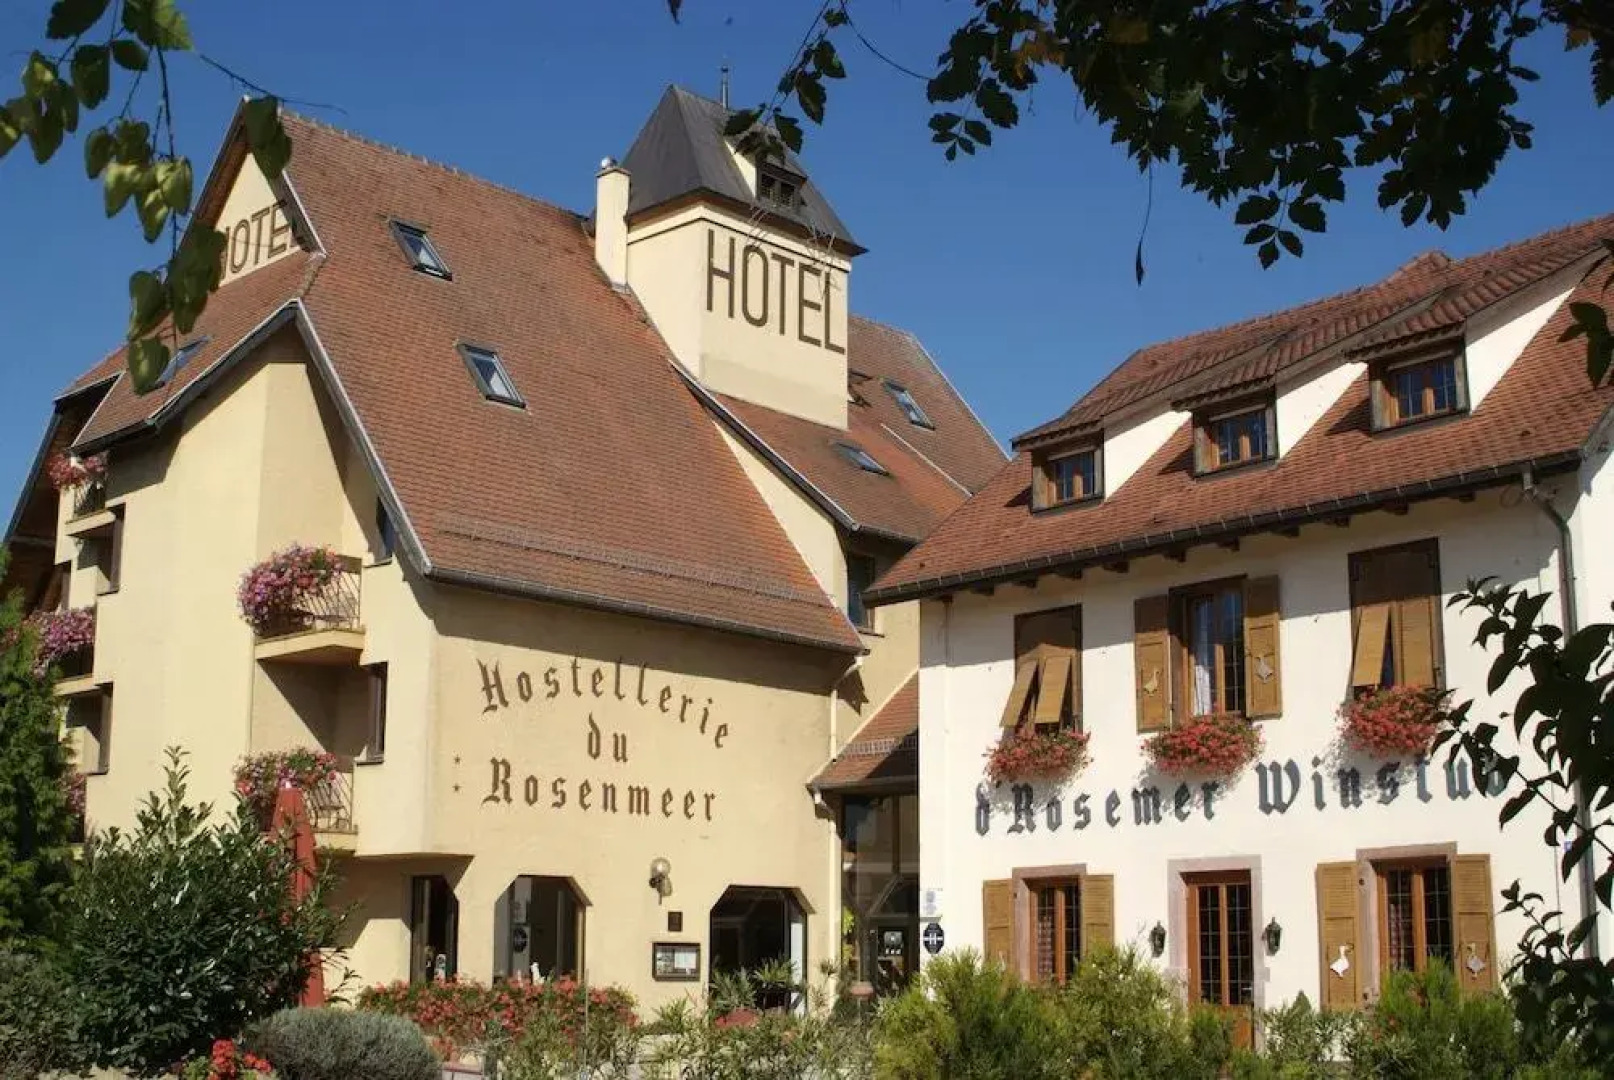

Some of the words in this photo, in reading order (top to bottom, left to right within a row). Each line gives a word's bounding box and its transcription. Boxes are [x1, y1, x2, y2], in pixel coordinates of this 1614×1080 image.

[707, 229, 846, 355] HOTEL
[477, 656, 729, 749] Hostellerie
[587, 712, 628, 763] du
[481, 757, 718, 821] Rosenmeer
